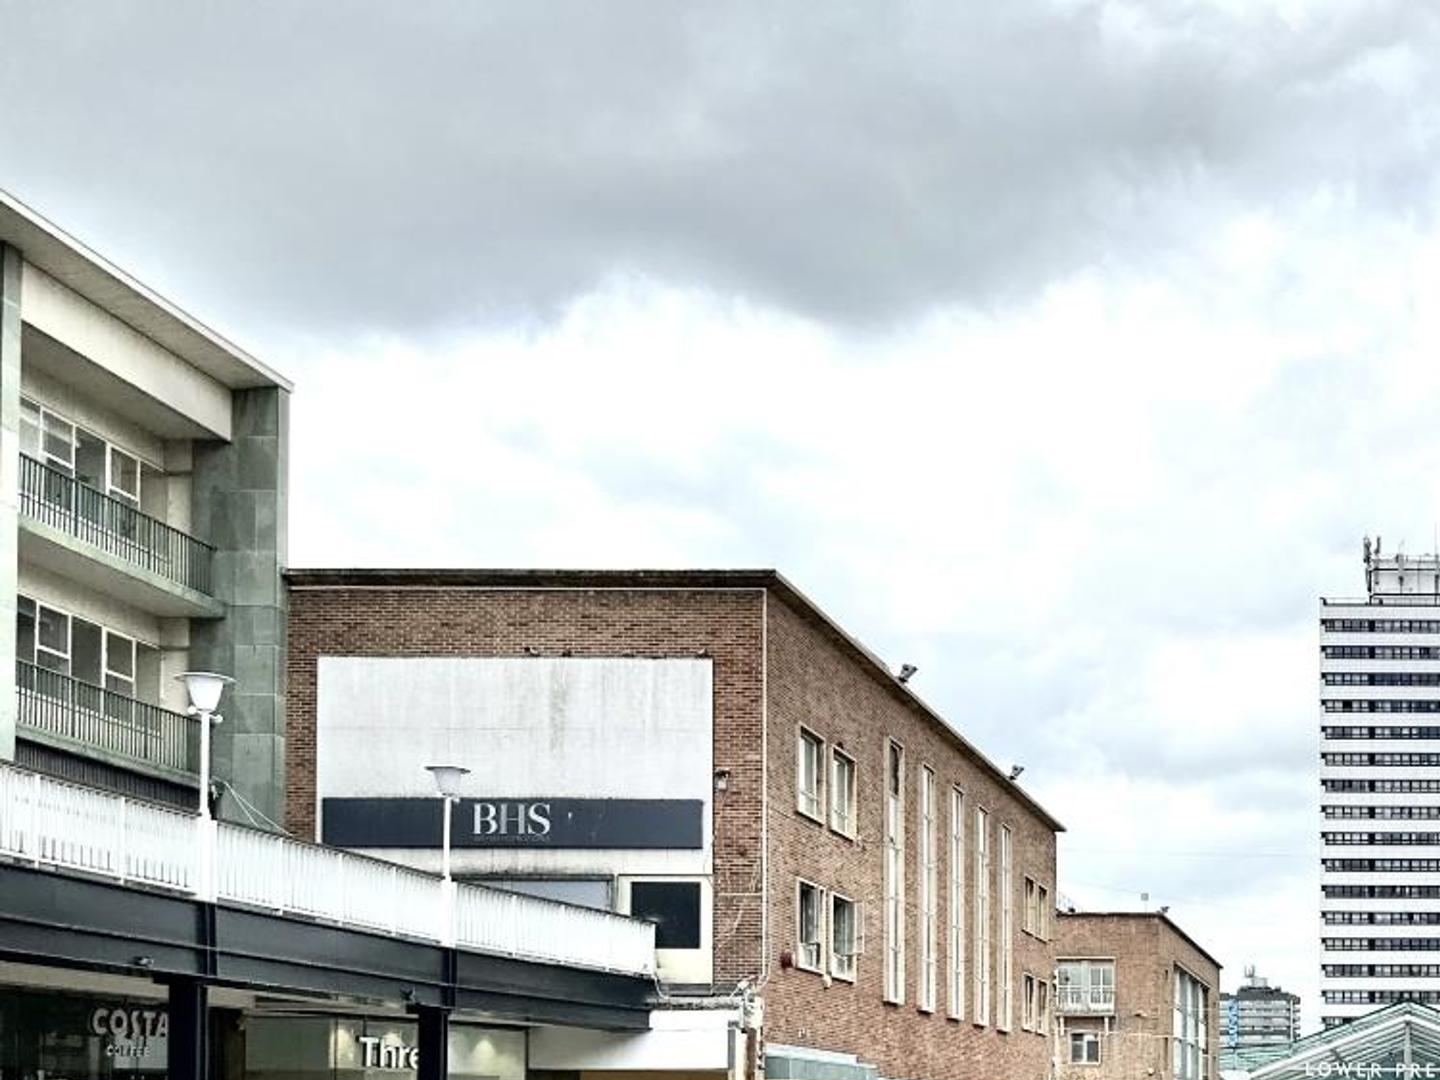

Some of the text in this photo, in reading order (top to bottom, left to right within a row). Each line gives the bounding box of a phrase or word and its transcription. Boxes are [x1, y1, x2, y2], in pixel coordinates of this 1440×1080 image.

[473, 802, 551, 834] BHS
[92, 1008, 169, 1040] COSTA
[1304, 1061, 1383, 1078] LOWER
